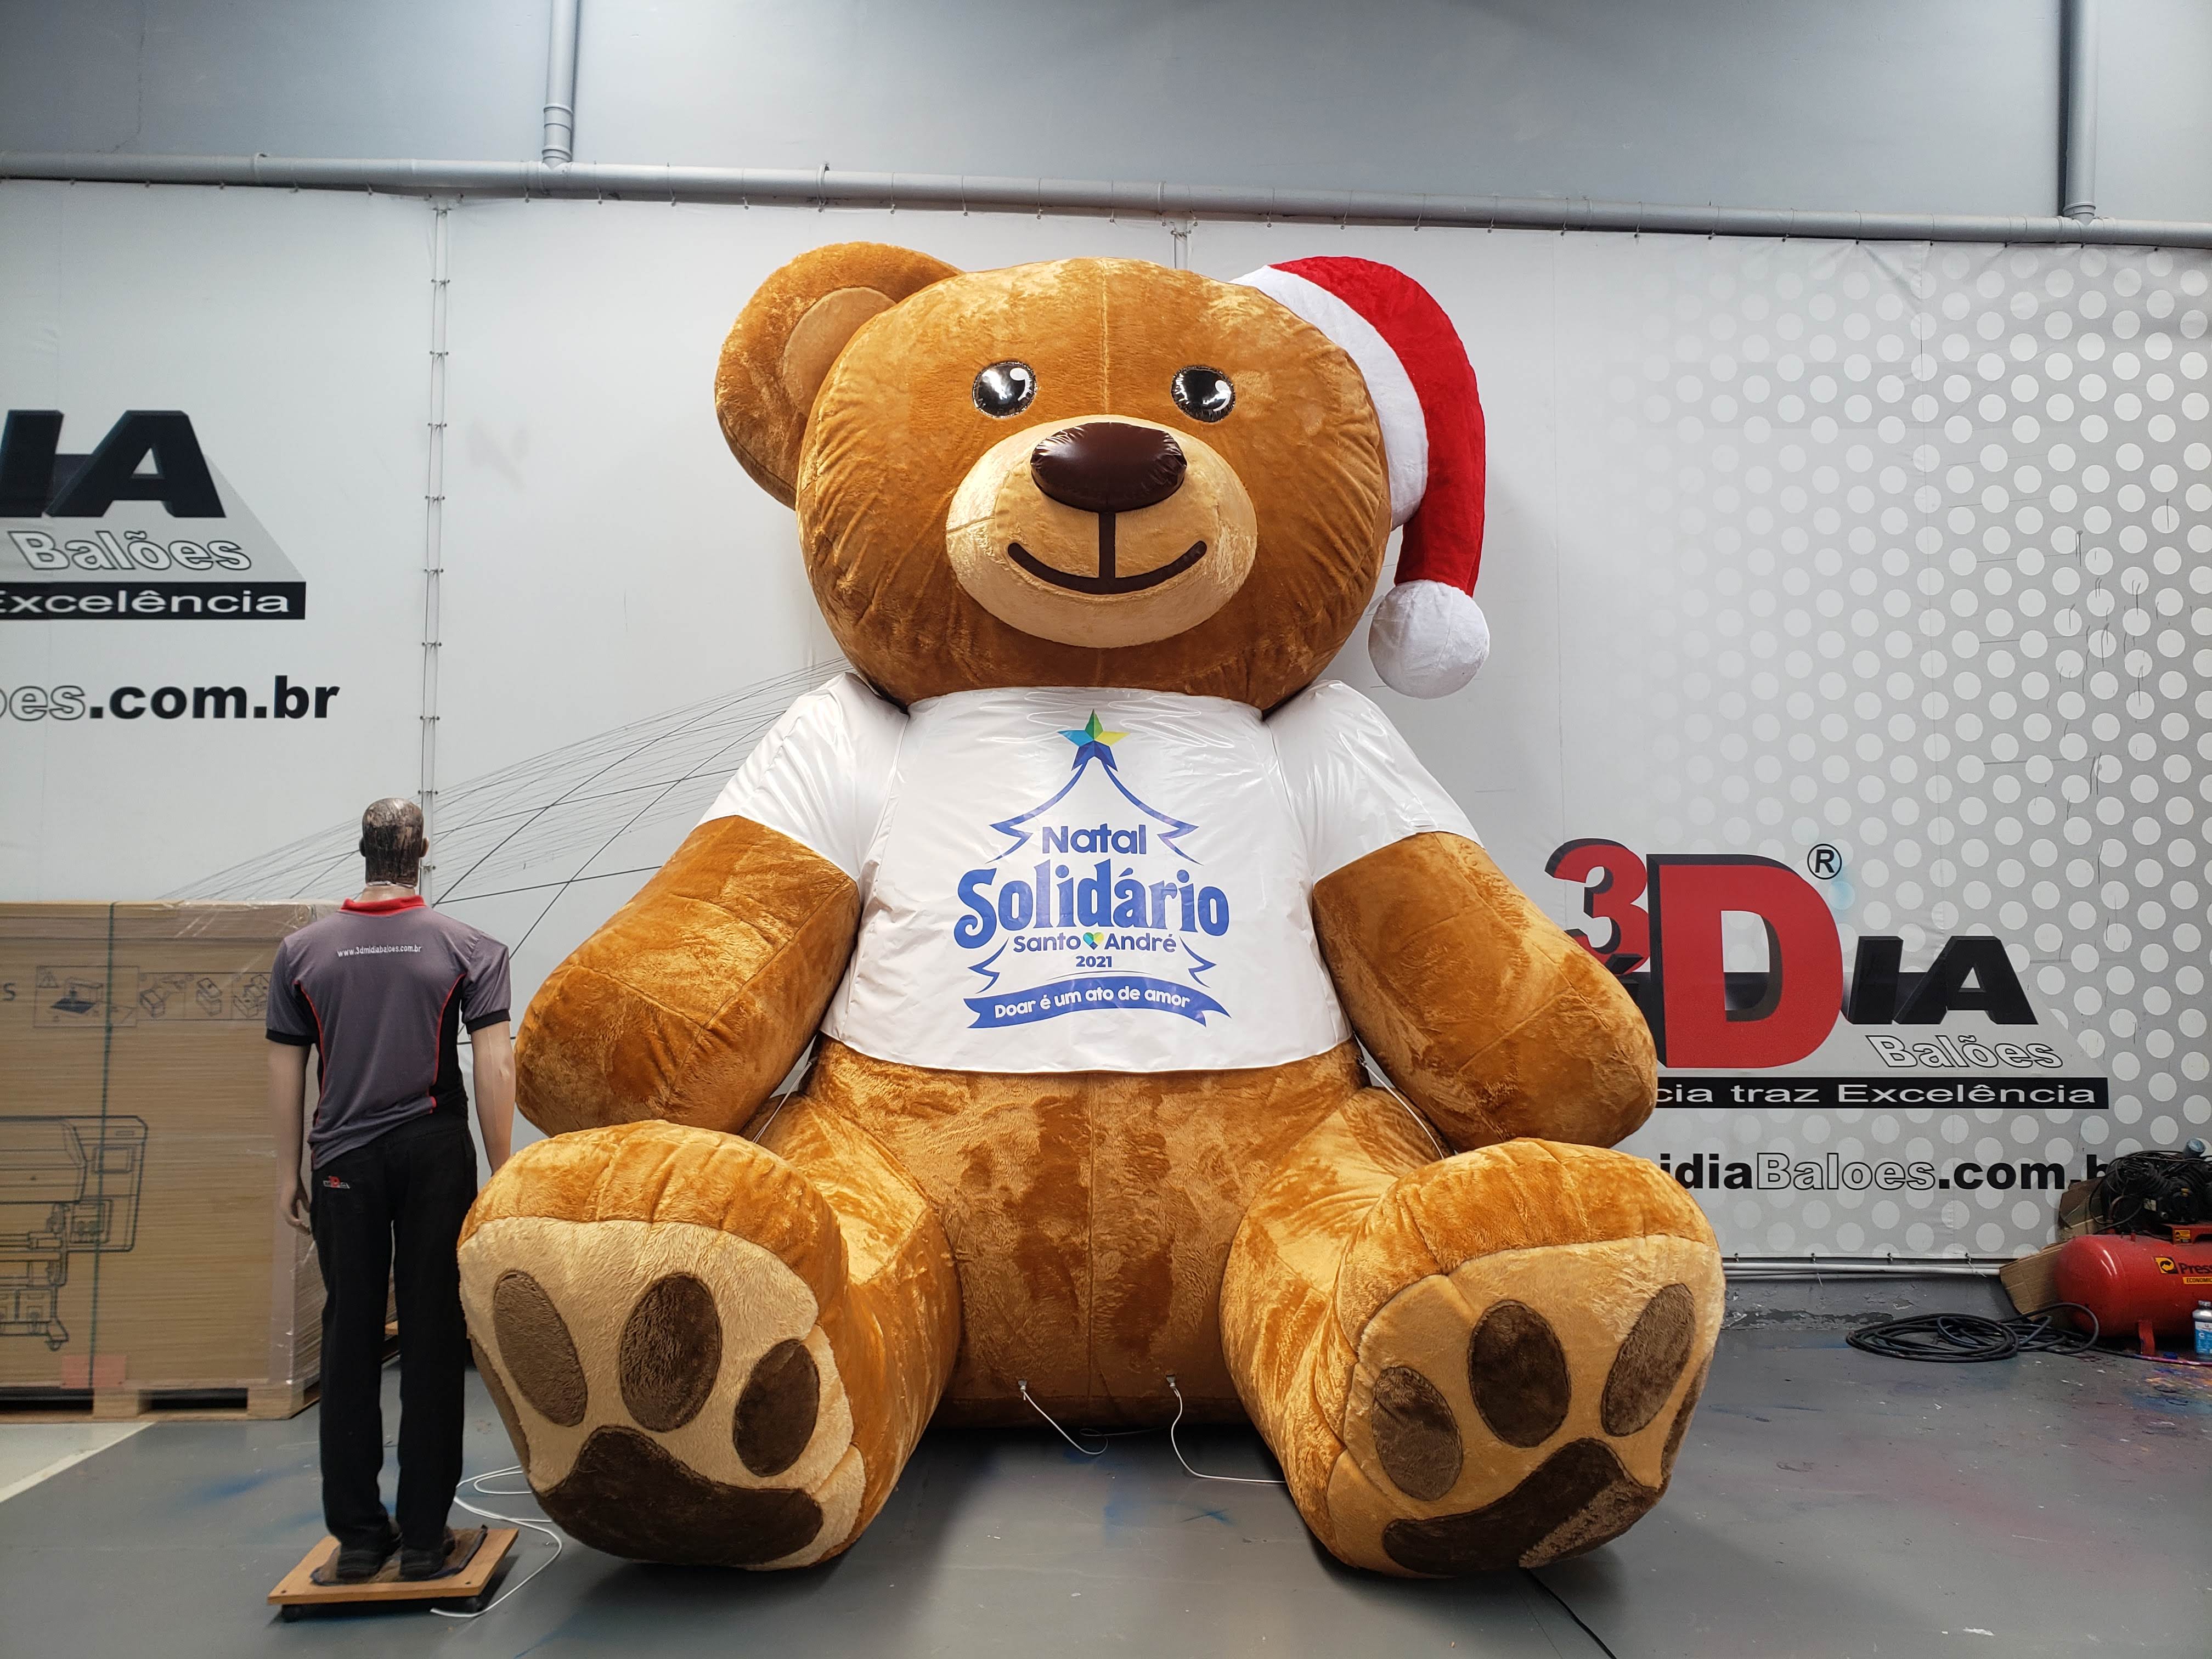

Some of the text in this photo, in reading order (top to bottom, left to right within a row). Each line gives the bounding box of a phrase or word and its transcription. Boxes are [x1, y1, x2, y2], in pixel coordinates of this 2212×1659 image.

[7, 530, 252, 571] Balões
[0, 590, 290, 613] xcelência
[0, 675, 340, 721] es.com.br
[1042, 823, 1146, 854] Natal
[953, 859, 1229, 949] Solidário
[337, 944, 422, 957] www.3dmidiabaloes.com.br
[1013, 933, 1177, 953] Santo André
[1075, 956, 1113, 968] 2021
[994, 985, 1190, 1019] Doar é um ato de amor
[1865, 1035, 2063, 1068] Balões
[1730, 1085, 1820, 1103] traz
[1838, 1084, 2096, 1103] Excelência
